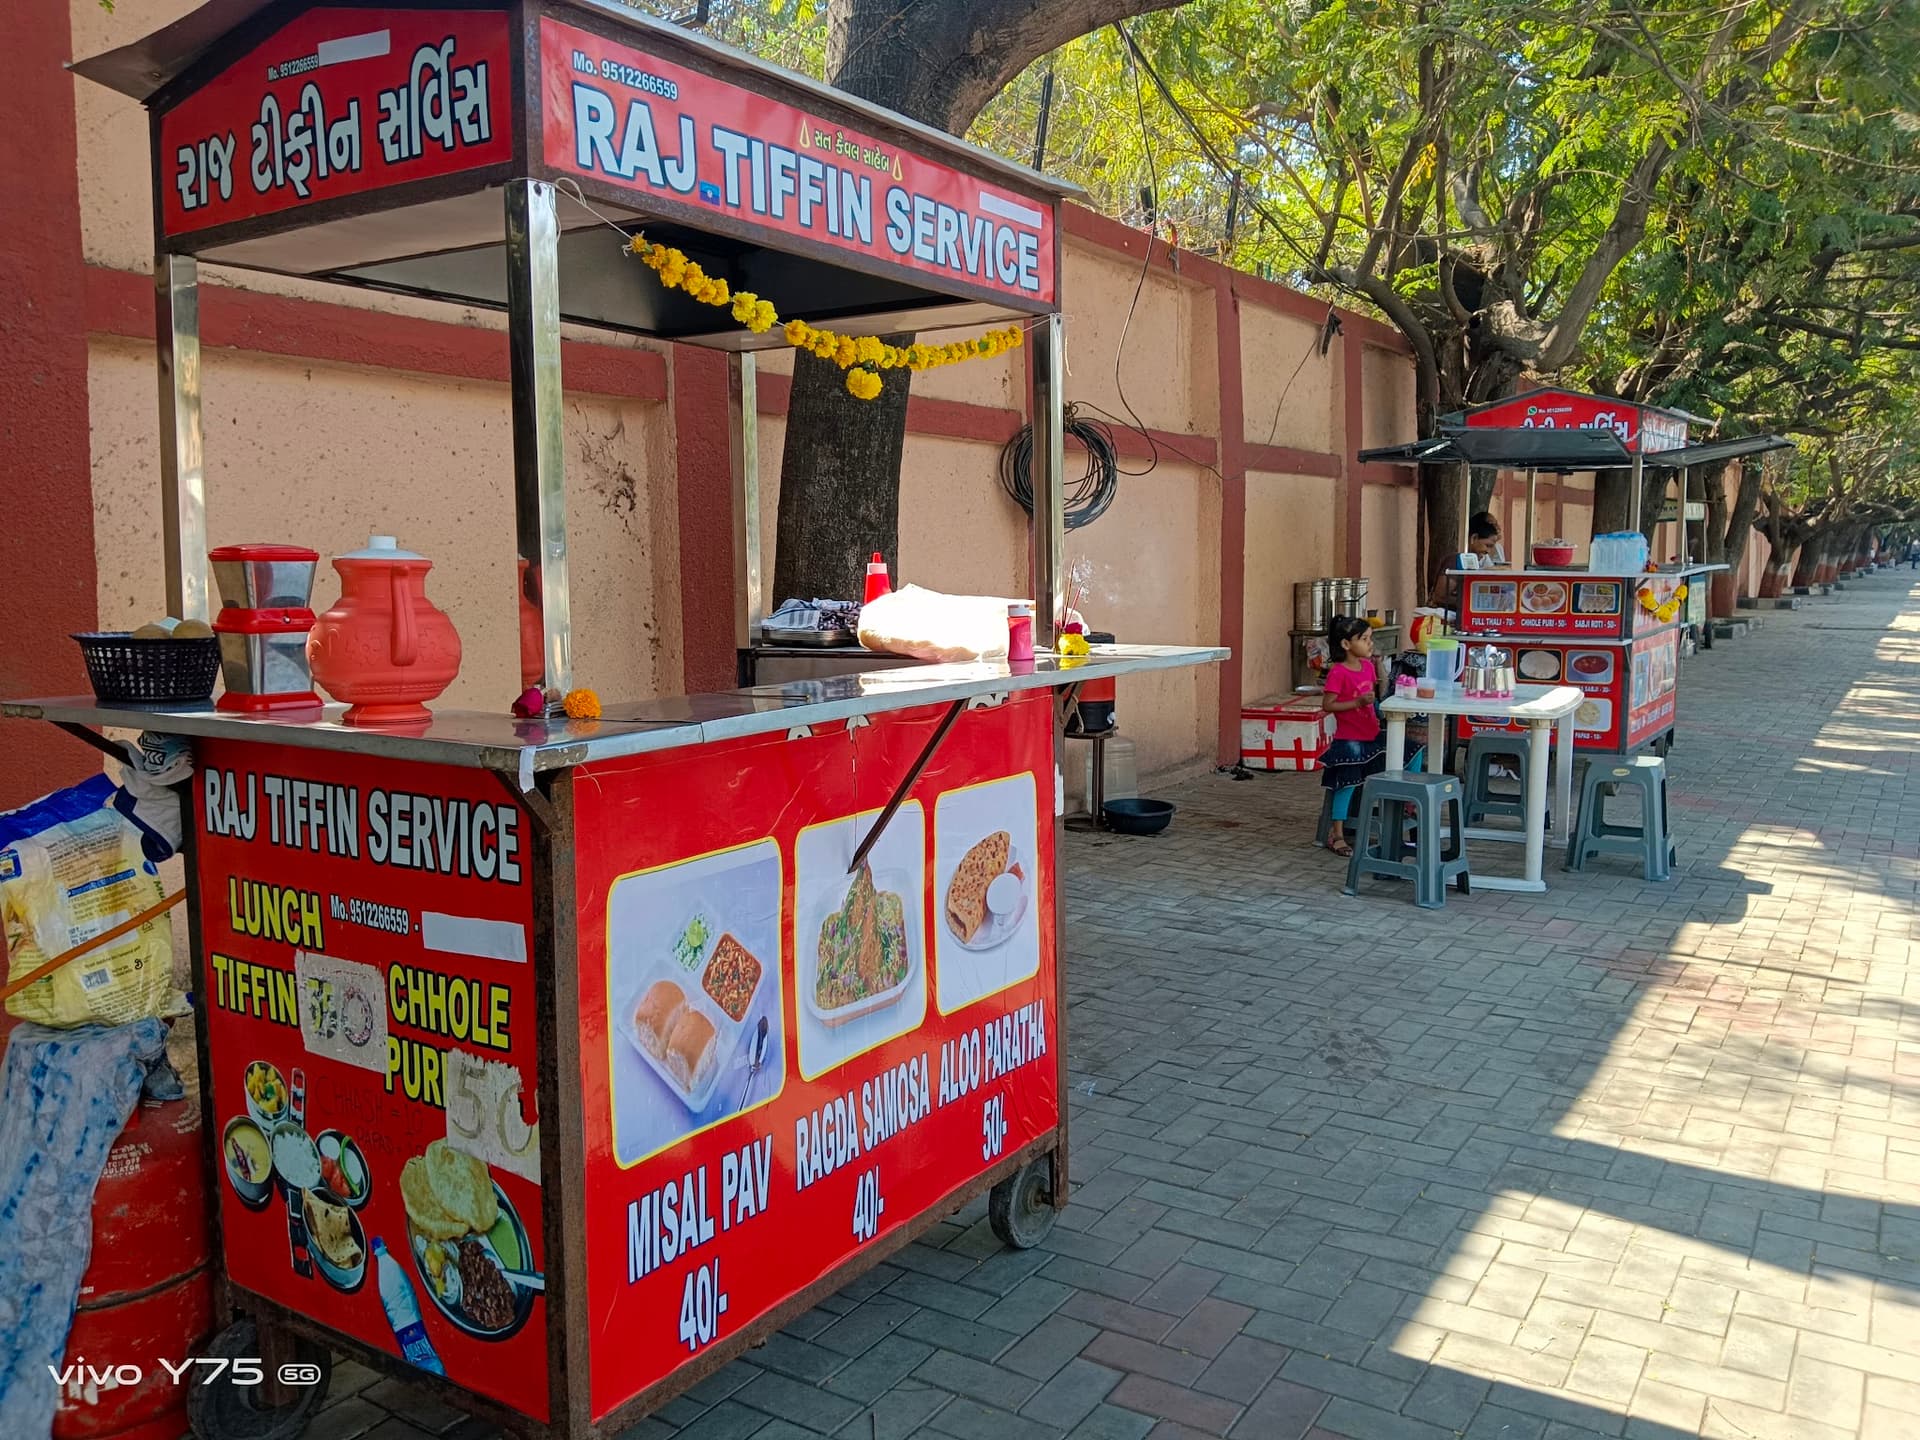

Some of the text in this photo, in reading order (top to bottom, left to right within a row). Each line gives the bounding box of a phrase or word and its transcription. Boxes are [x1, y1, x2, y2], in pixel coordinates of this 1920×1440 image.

[572, 51, 679, 101] Mo. 9512266559
[177, 37, 491, 211] રાજ ટીફીન સર્વિસ
[572, 82, 1042, 292] RAJ TIFFIN SERVICE
[204, 768, 522, 884] RAJ TIFFIN SERVICE
[228, 877, 324, 950] LUNCH
[330, 894, 349, 921] Mo.
[349, 898, 410, 935] 9512266559
[211, 954, 299, 1027] TIFFIN
[389, 963, 511, 1050] CHHOLE
[937, 999, 1047, 1109] ALOO PARATHA
[795, 1051, 931, 1191] RAGDA SAMOSA
[981, 1092, 1009, 1162] 50/-
[627, 1135, 773, 1285] MISAL PAV
[852, 1165, 885, 1243] 40/-
[679, 1257, 728, 1351] 40/-
